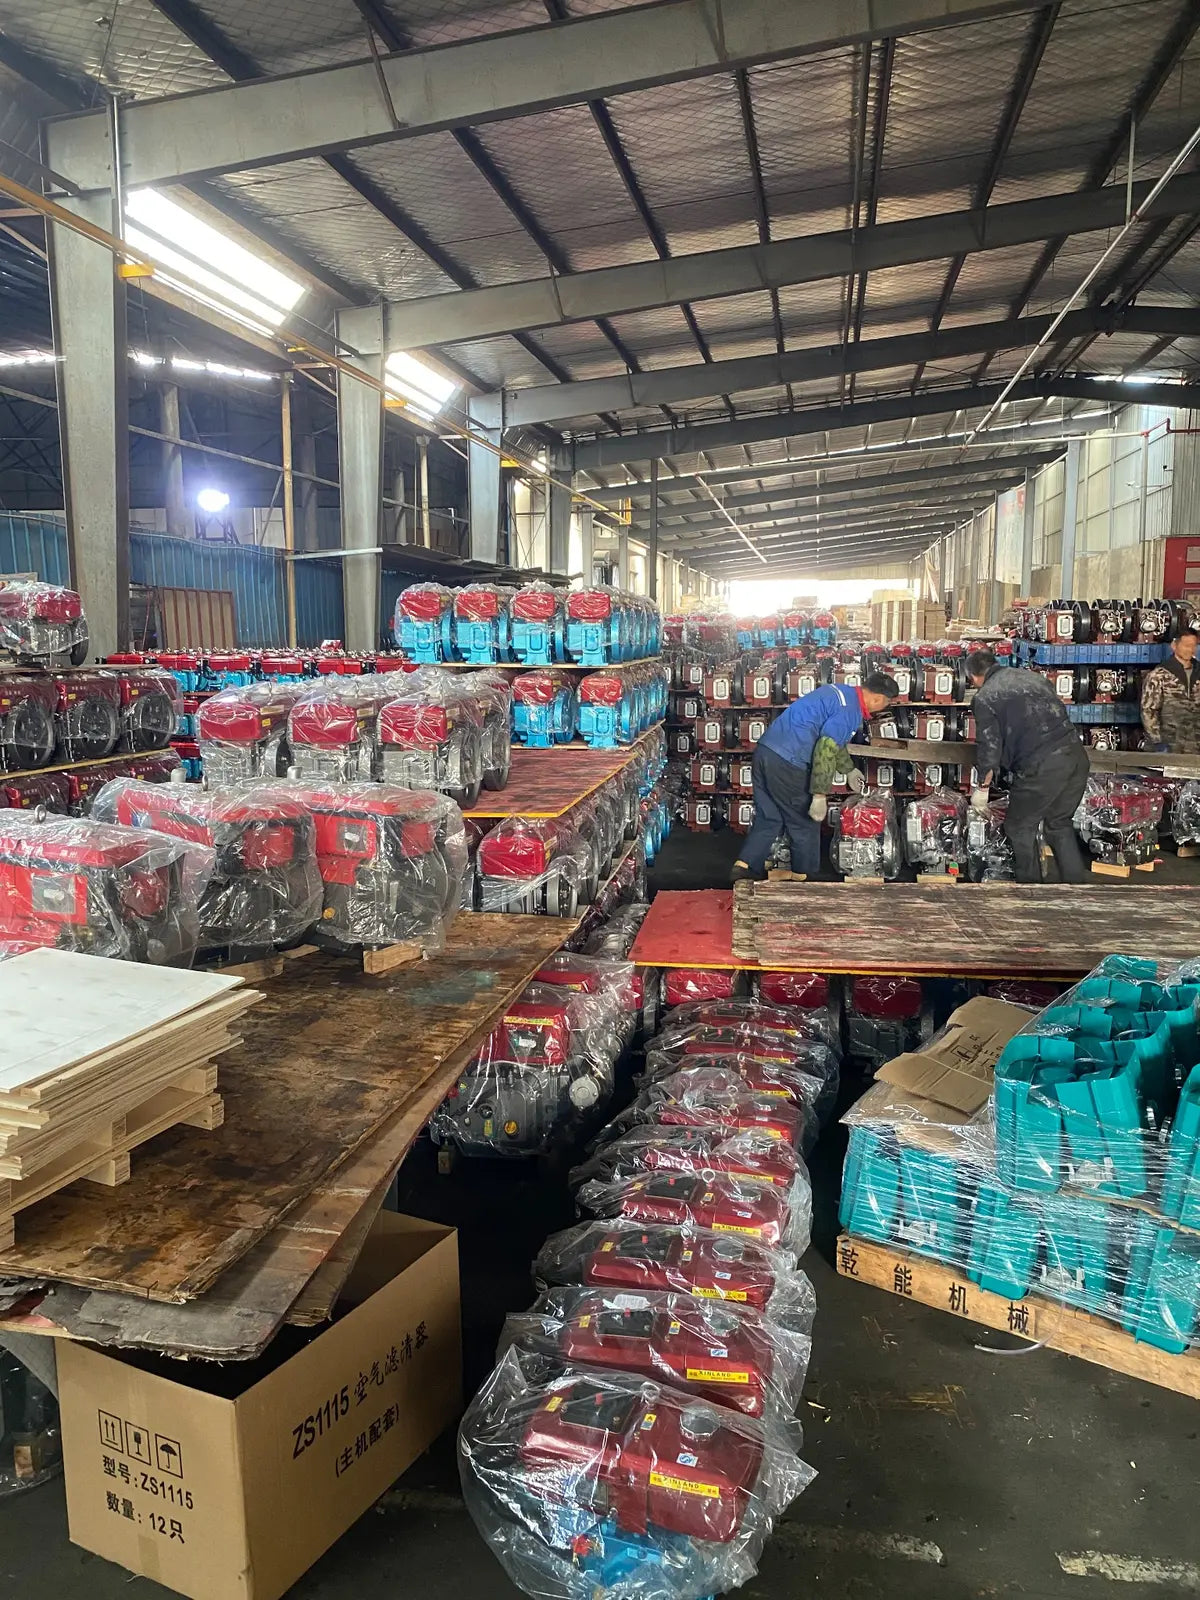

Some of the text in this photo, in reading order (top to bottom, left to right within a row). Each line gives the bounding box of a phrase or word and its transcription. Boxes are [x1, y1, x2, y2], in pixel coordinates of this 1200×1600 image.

[292, 1384, 349, 1460] ZS1115
[335, 1402, 399, 1478] (主机配套)
